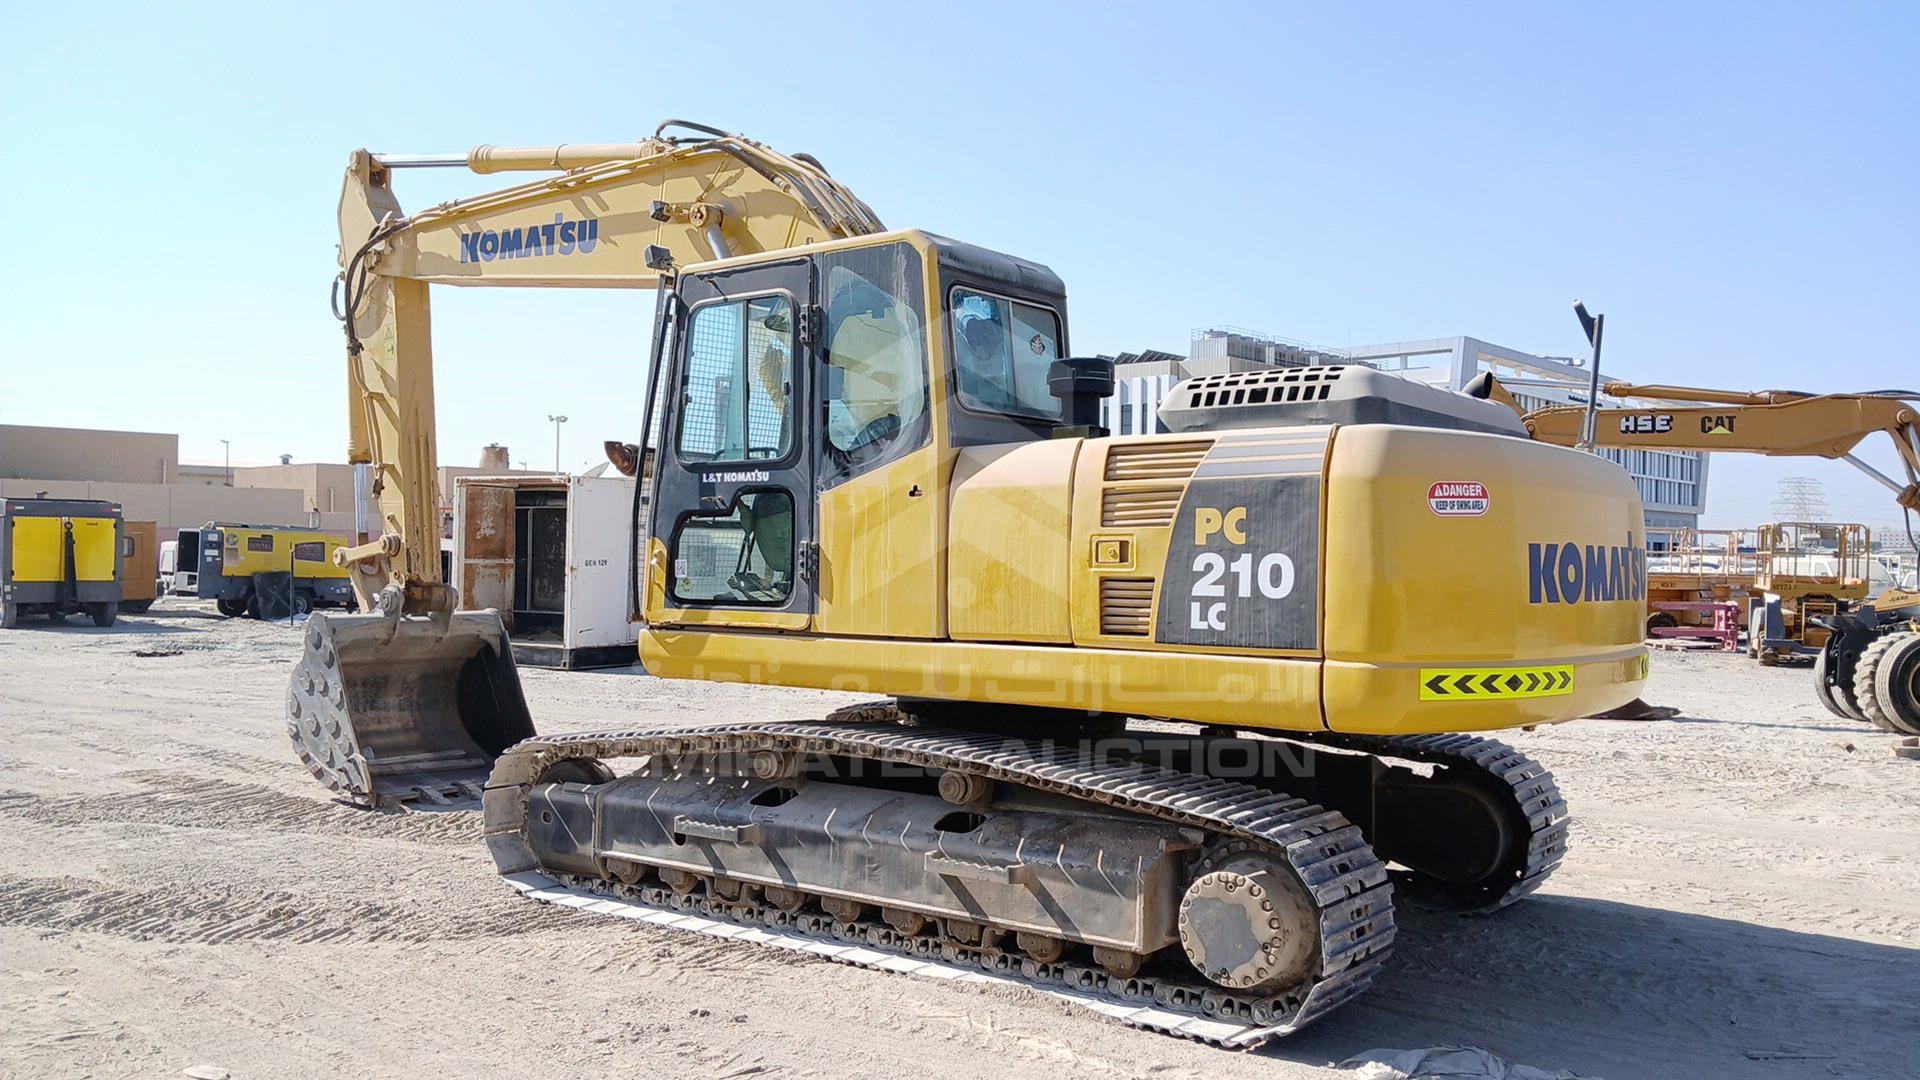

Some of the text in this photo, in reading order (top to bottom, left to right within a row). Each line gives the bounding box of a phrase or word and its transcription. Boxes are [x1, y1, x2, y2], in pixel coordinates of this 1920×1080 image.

[460, 212, 598, 264] KOMATSU
[1620, 414, 1673, 434] HSE
[1701, 415, 1736, 434] CAT
[702, 469, 770, 483] L&T KOMATSU
[1442, 484, 1483, 497] DANGER
[1435, 500, 1448, 510] KEEP
[1195, 506, 1248, 546] PC
[1191, 552, 1295, 599] 210
[1528, 530, 1646, 605] KOMATSU
[1190, 601, 1227, 631] LC
